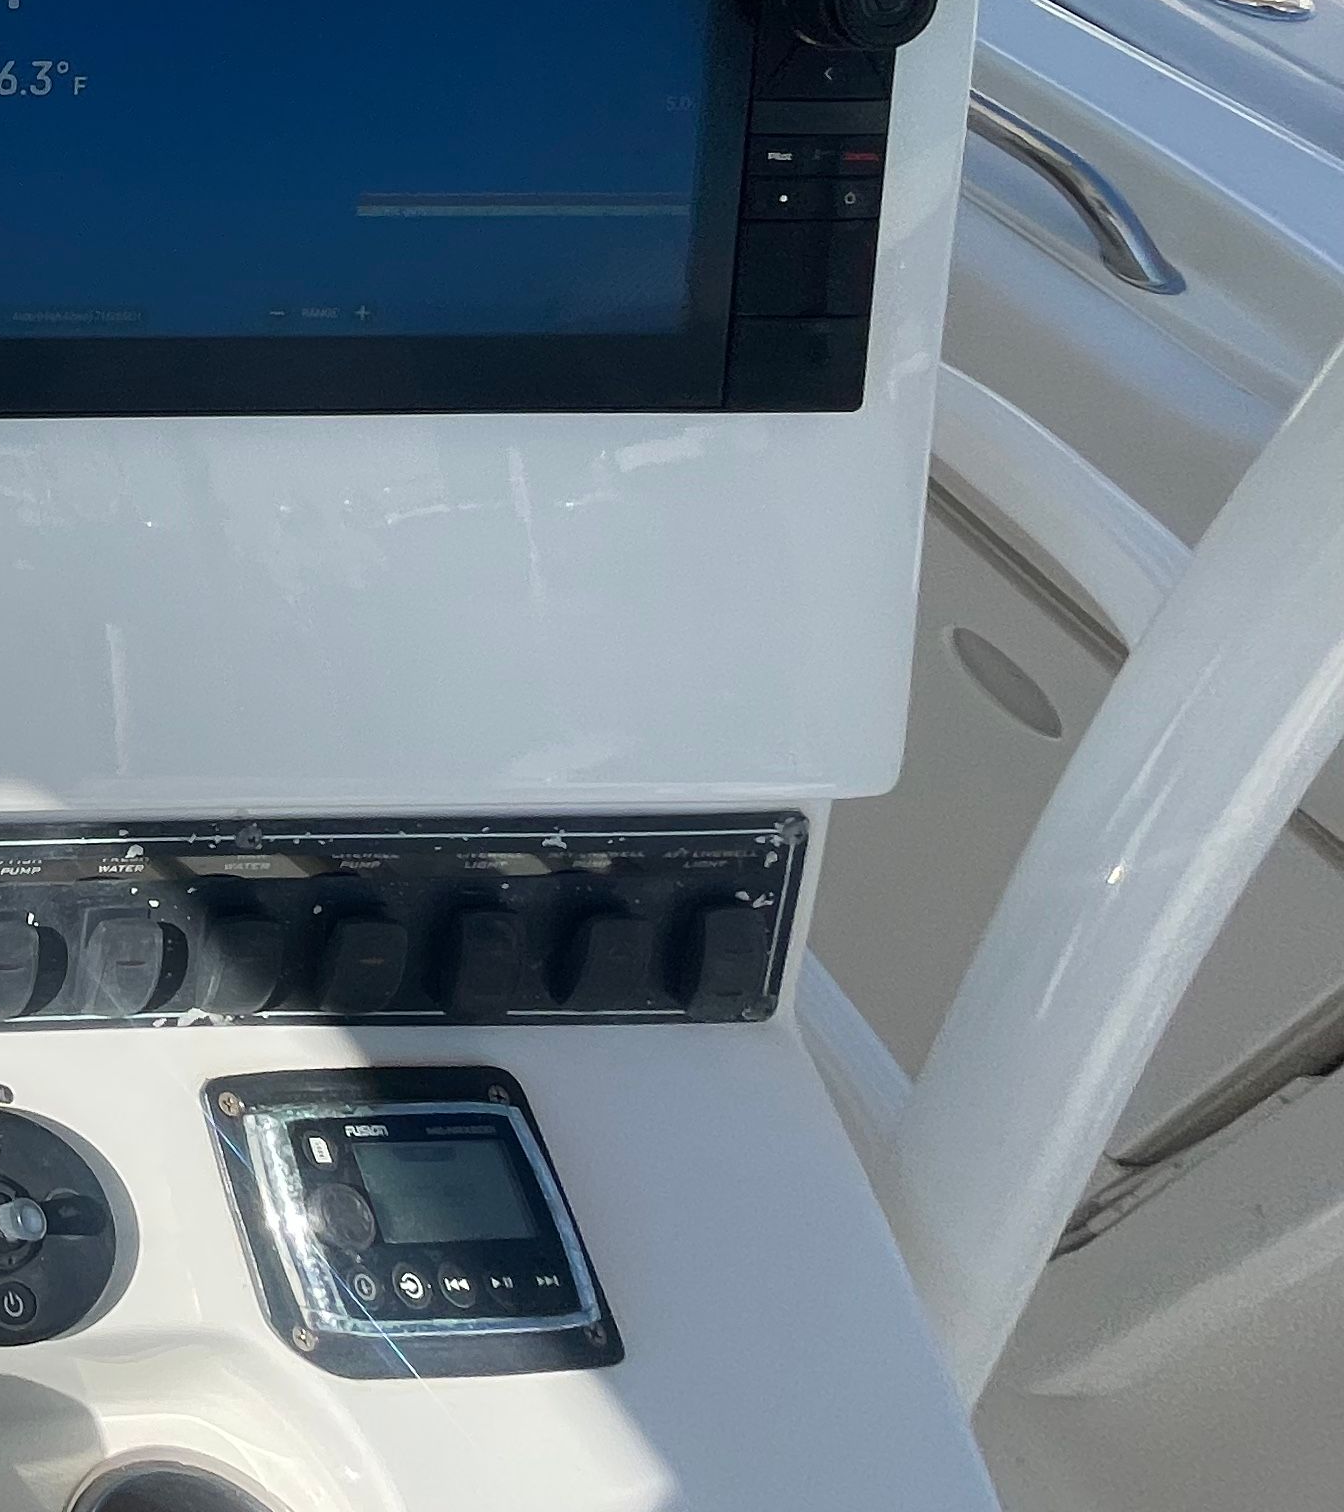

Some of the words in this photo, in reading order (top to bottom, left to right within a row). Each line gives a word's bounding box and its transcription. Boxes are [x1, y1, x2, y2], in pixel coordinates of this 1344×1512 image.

[0, 866, 42, 876] PUMP
[98, 864, 144, 873] WATER
[344, 1124, 389, 1138] FUSION
